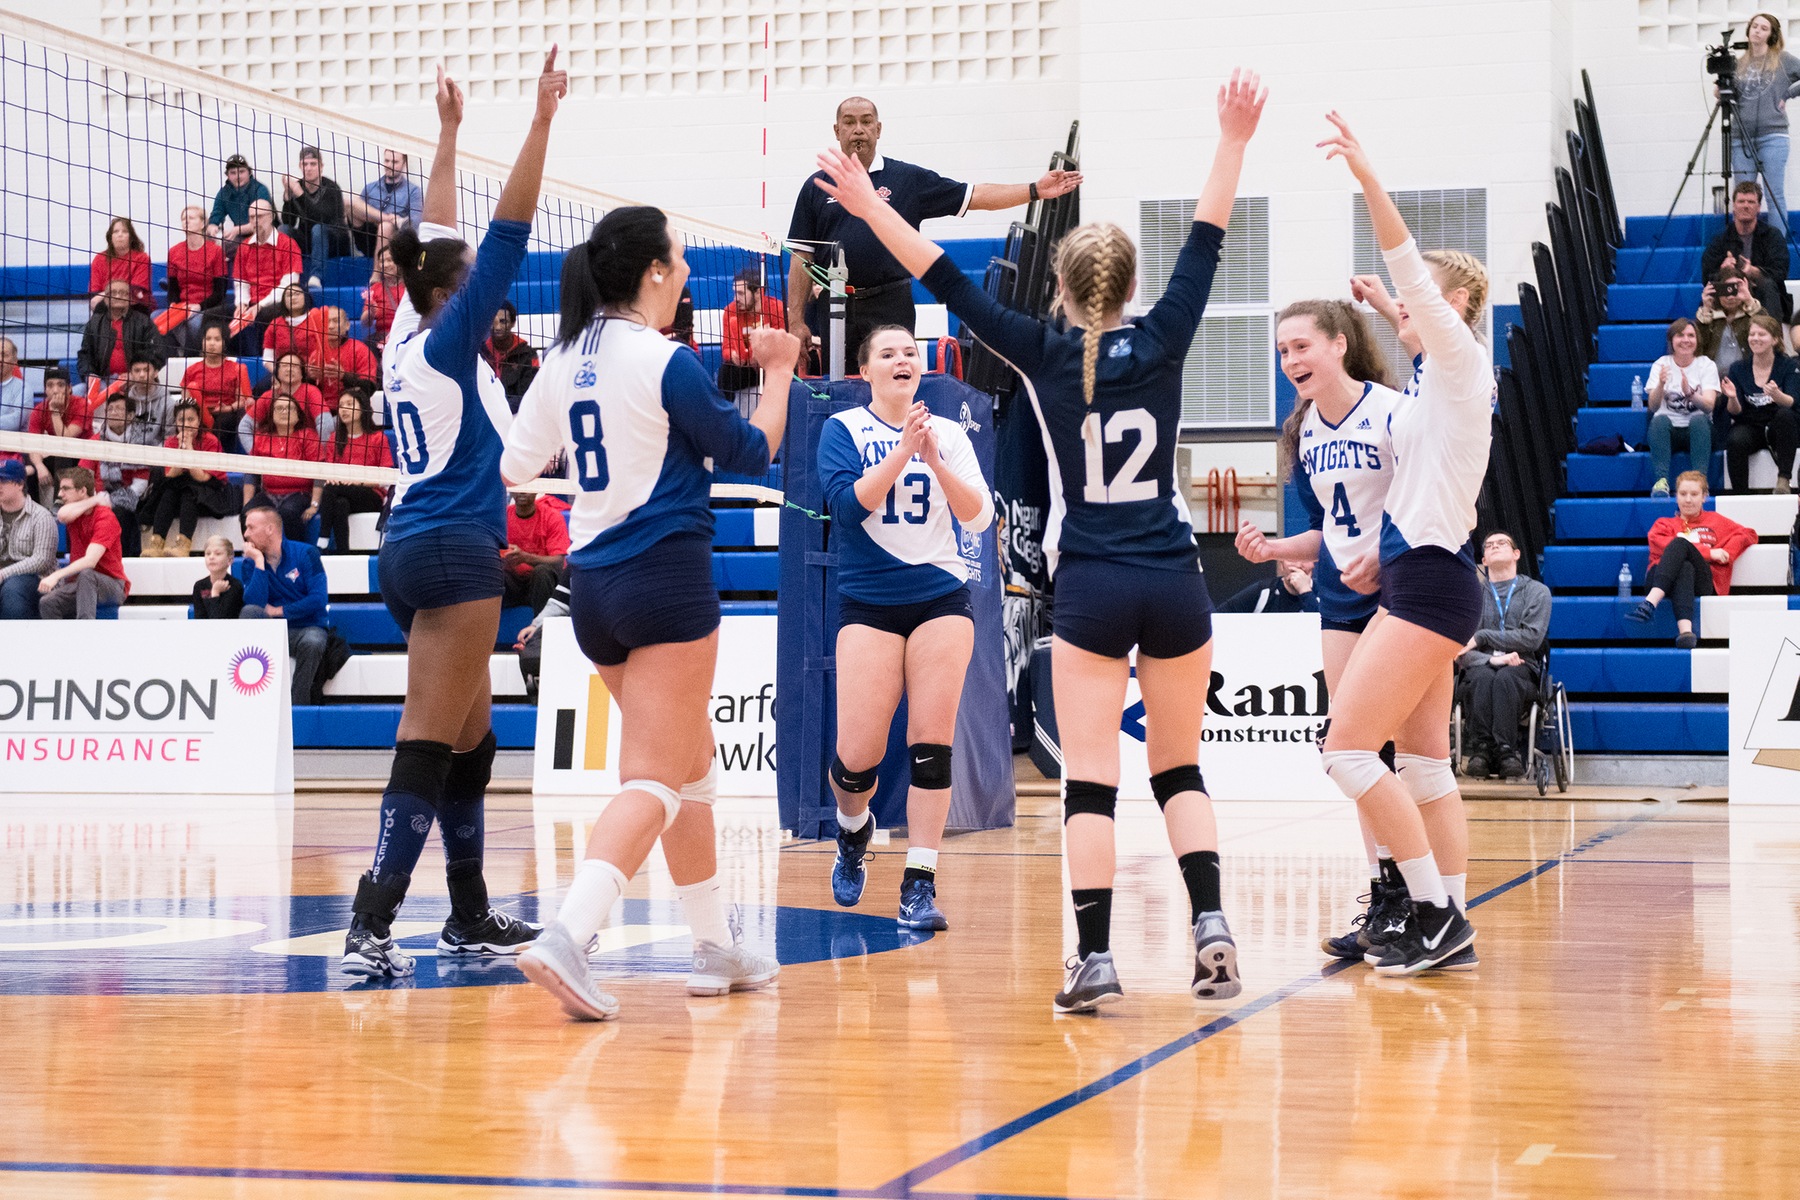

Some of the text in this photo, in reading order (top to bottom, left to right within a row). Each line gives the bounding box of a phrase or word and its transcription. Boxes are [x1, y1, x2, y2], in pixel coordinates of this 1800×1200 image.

[390, 401, 430, 475] 0
[569, 400, 610, 492] 8
[1081, 408, 1159, 504] 12
[882, 473, 931, 525] 13
[1331, 482, 1361, 537] 4
[0, 679, 218, 721] OHNSON
[6, 738, 201, 761] NSURANCE
[1201, 722, 1322, 743] onstruct
